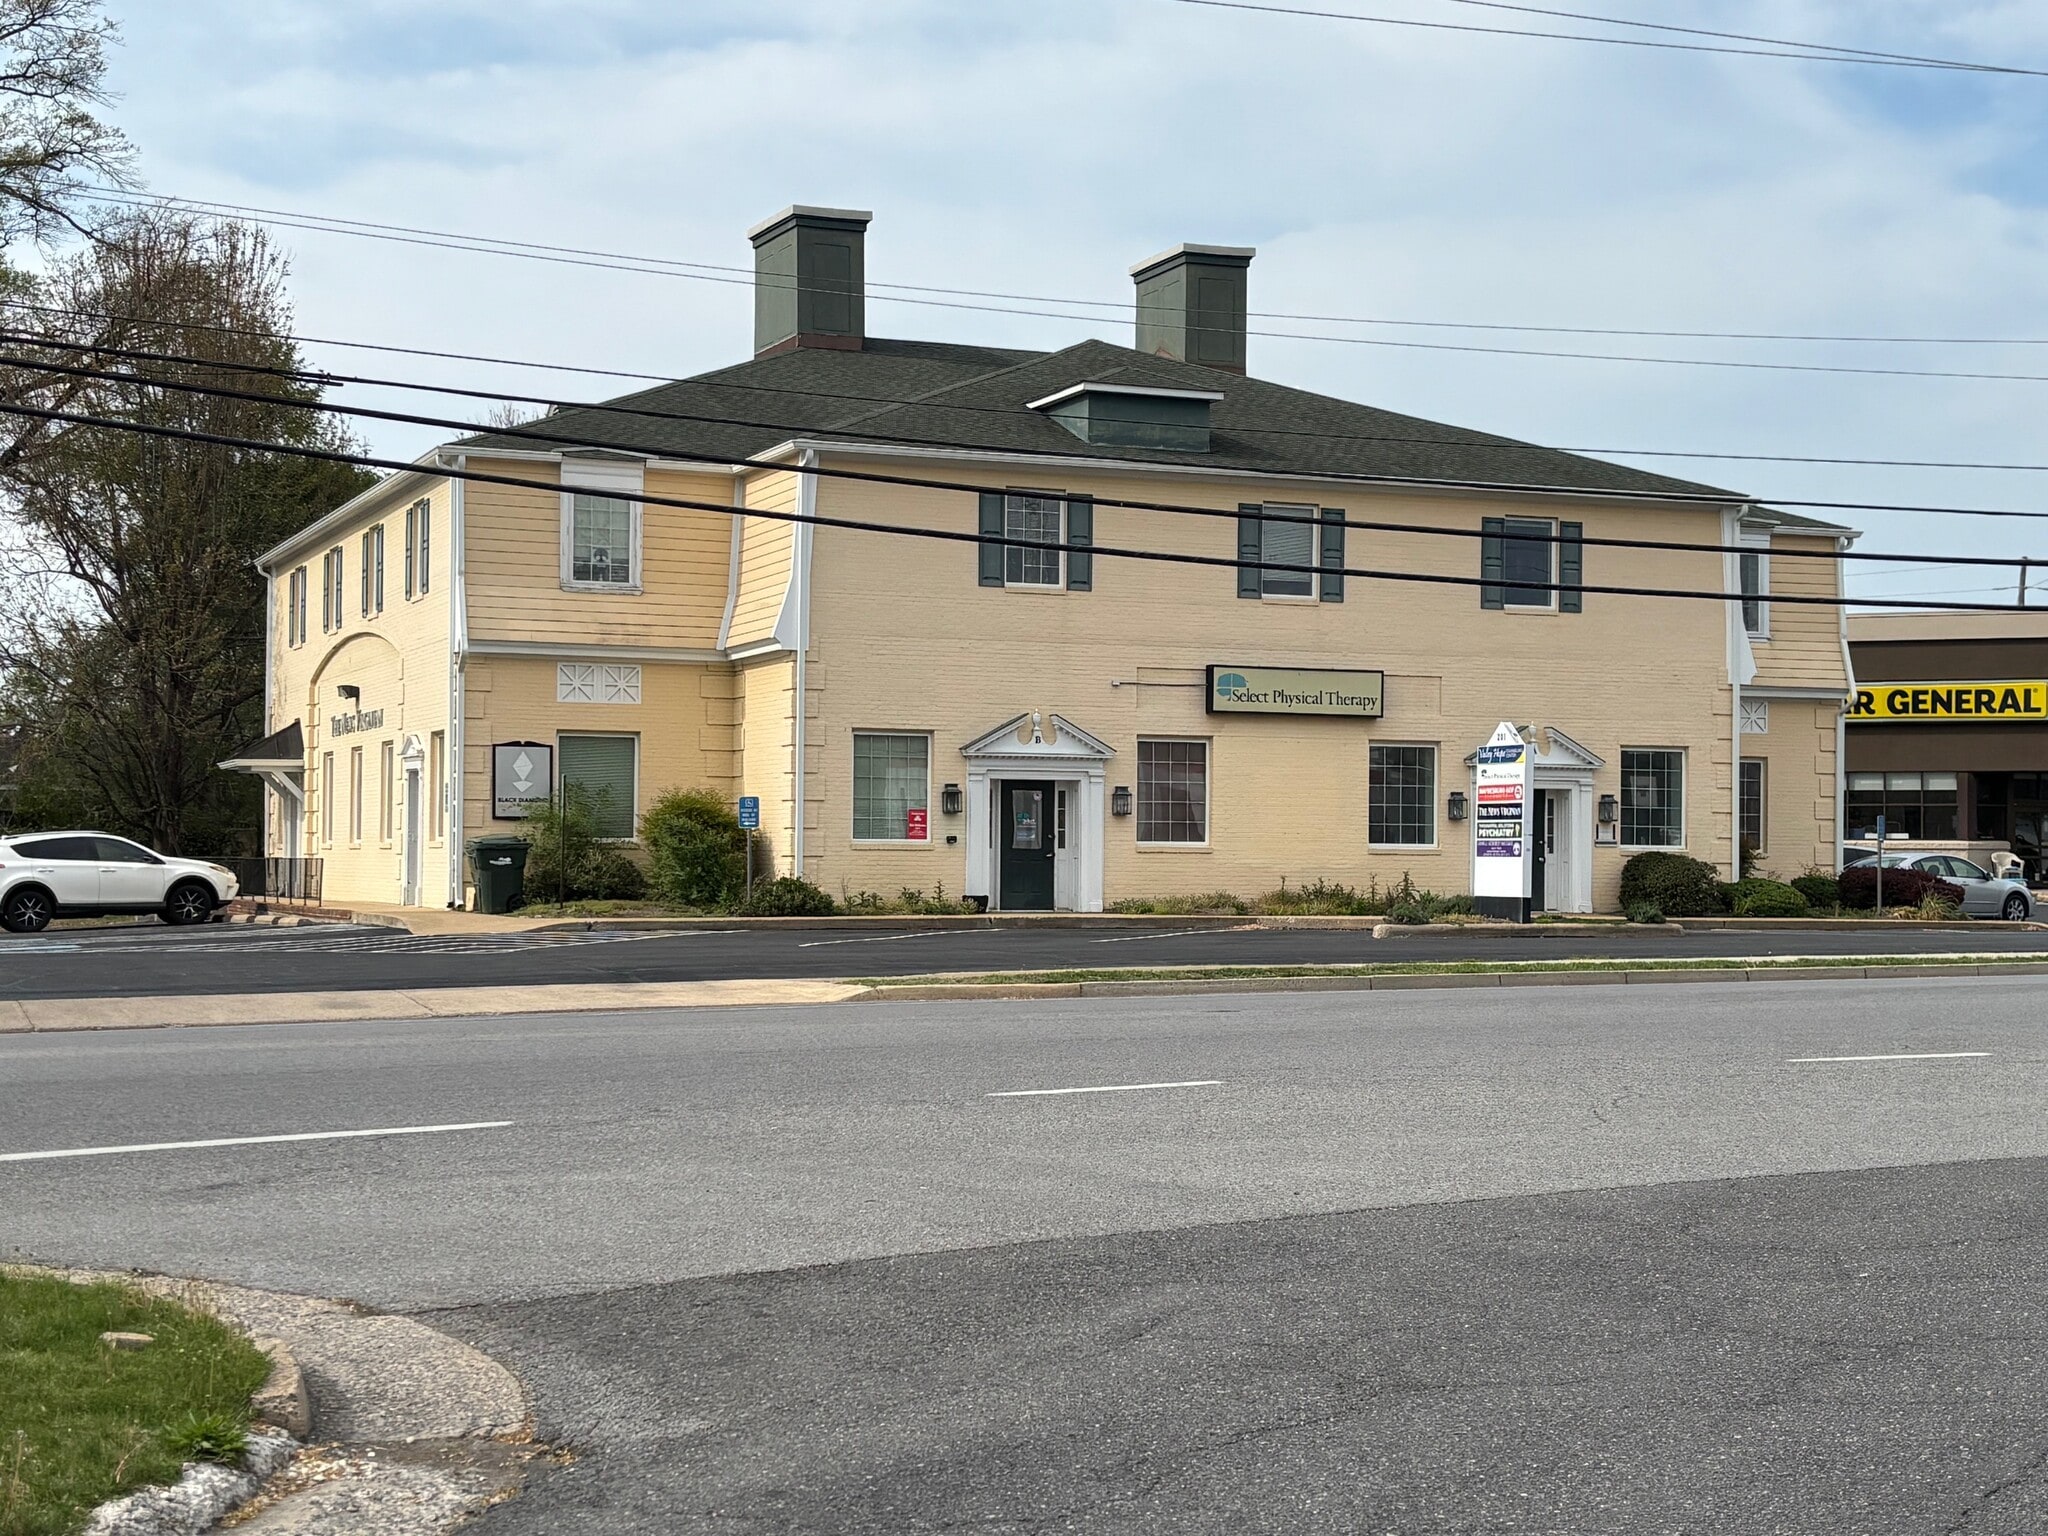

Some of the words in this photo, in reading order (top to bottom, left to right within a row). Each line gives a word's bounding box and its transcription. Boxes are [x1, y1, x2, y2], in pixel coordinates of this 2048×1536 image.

[1232, 688, 1269, 704] Select
[1273, 689, 1323, 707] Physical
[1325, 691, 1378, 710] Therapy
[1846, 691, 1876, 714] R
[1886, 688, 2042, 715] GENERAL
